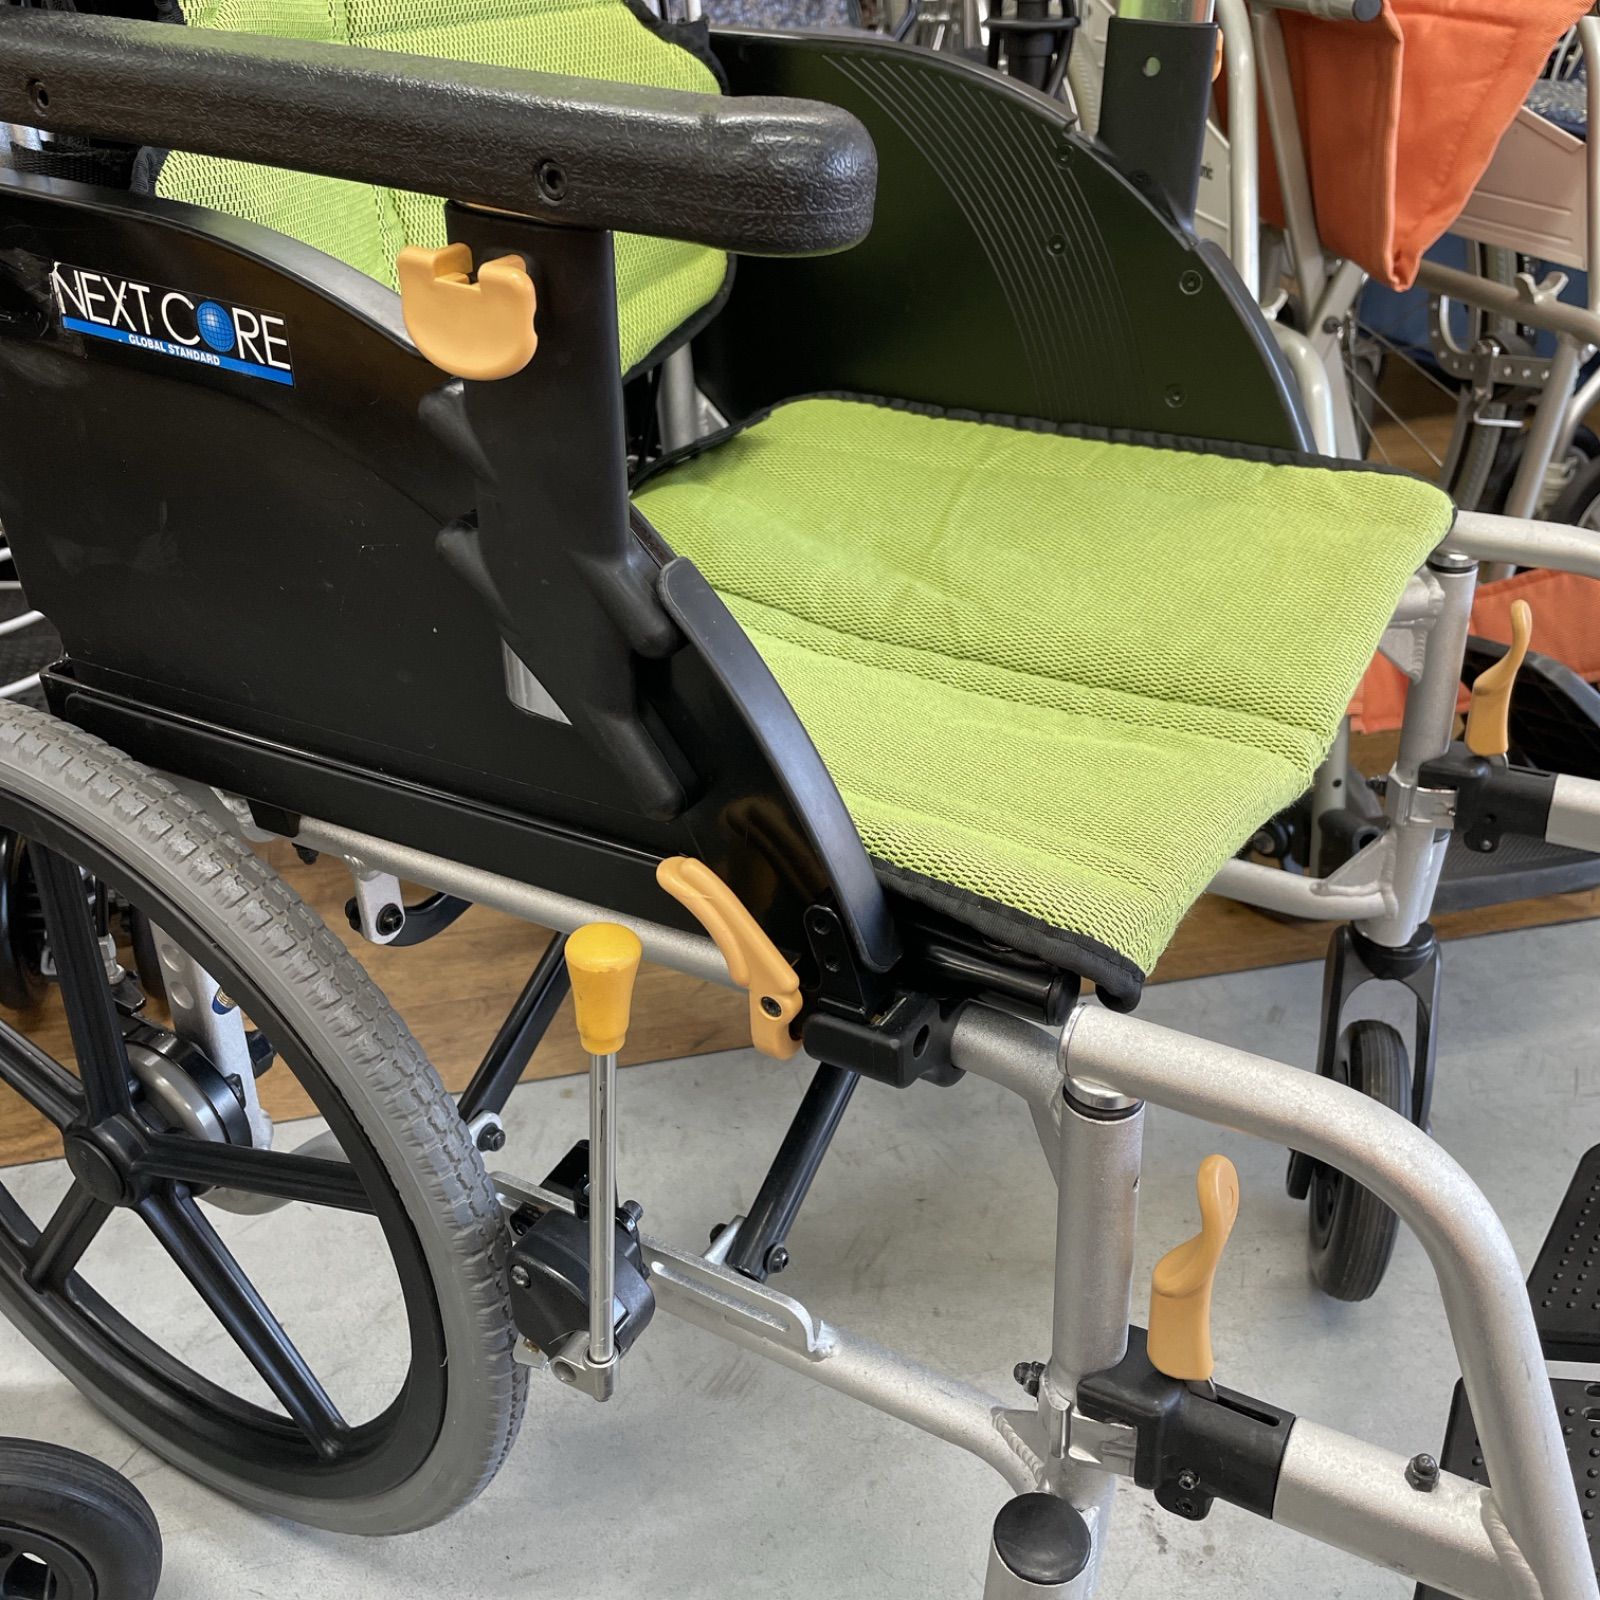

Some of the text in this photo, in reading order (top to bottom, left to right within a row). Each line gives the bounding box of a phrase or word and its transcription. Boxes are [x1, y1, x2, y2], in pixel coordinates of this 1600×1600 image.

[52, 262, 291, 370] NEXT CORE
[128, 334, 220, 366] GLOBAL STANDARD
